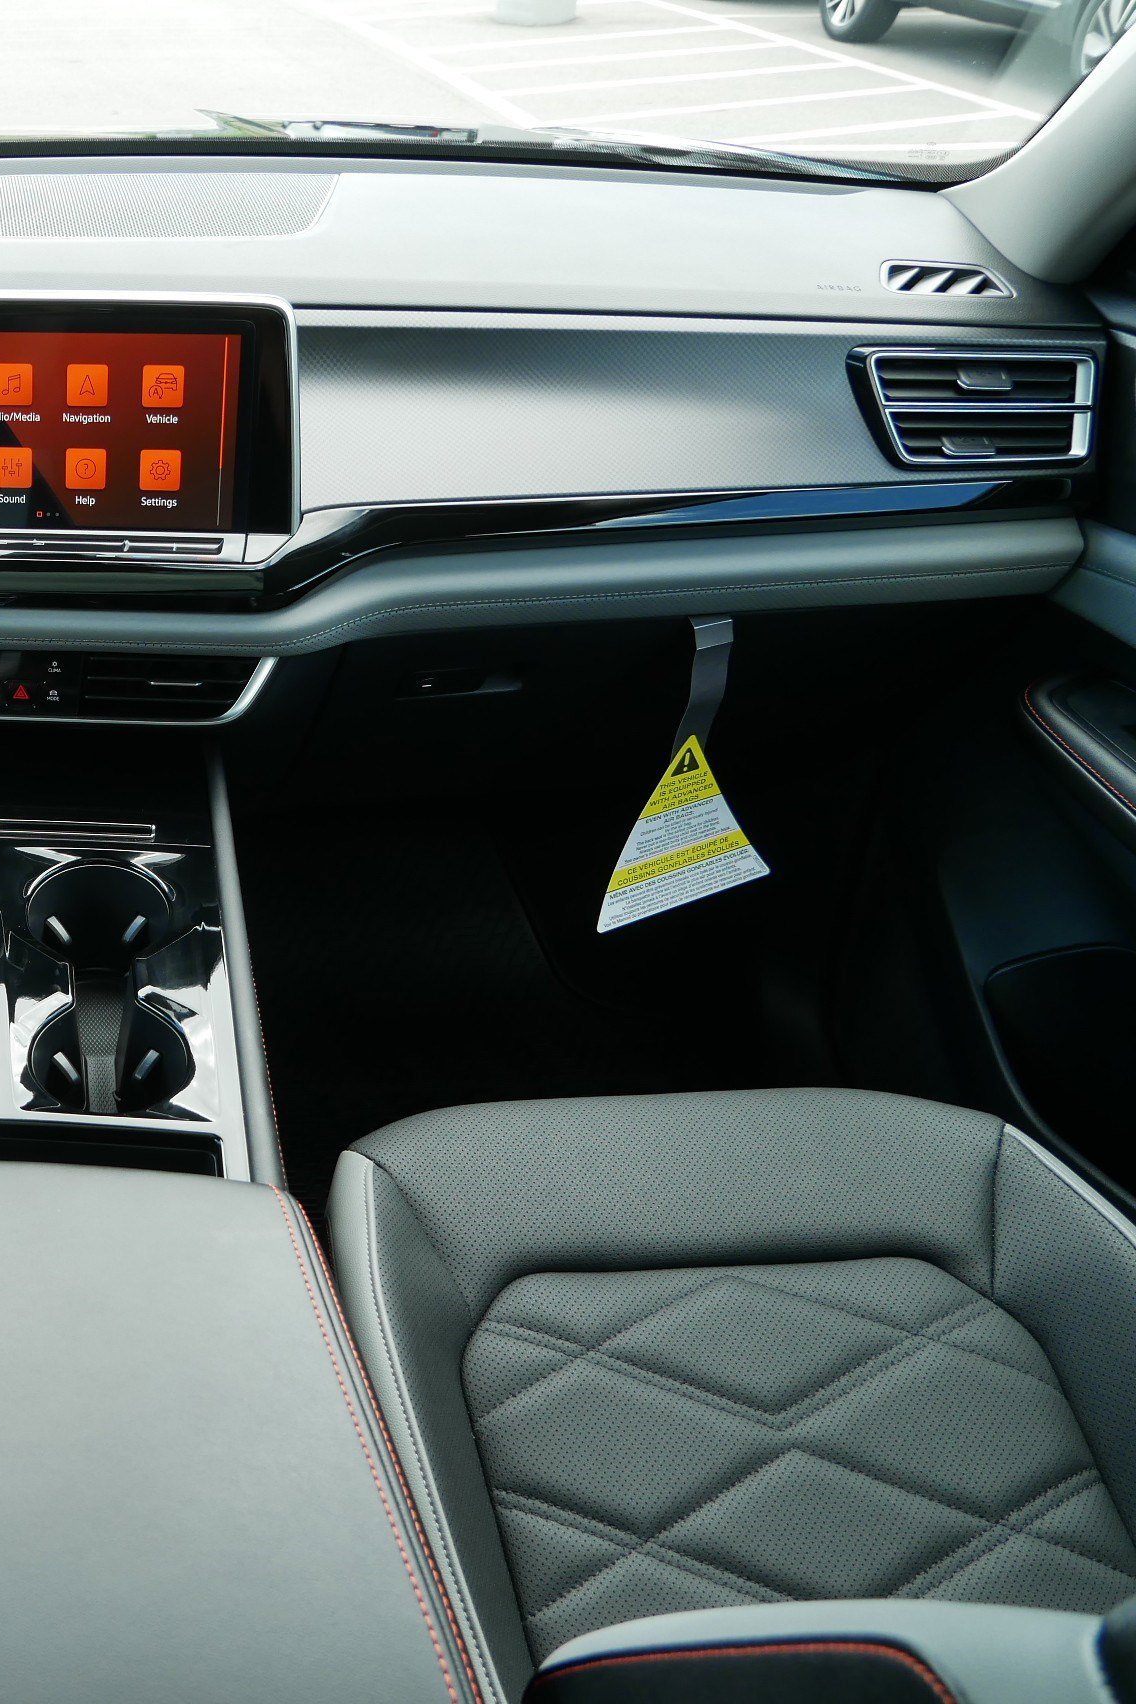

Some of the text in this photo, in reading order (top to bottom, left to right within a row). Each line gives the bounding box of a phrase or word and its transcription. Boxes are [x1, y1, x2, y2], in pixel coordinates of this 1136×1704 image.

[62, 413, 111, 424] Navigation
[146, 414, 179, 424] Vehicle
[75, 496, 96, 506] Help
[140, 497, 178, 508] Settings
[660, 771, 708, 790] THIS VEHICLE
[668, 779, 706, 794] EQUIPPED
[650, 783, 714, 806] WITH ADVANCED
[662, 794, 698, 810] AIR BAGS
[617, 869, 656, 886] COUSSINS
[658, 852, 705, 872] GONFLABLES
[628, 867, 638, 875] CE
[676, 849, 689, 859] EST
